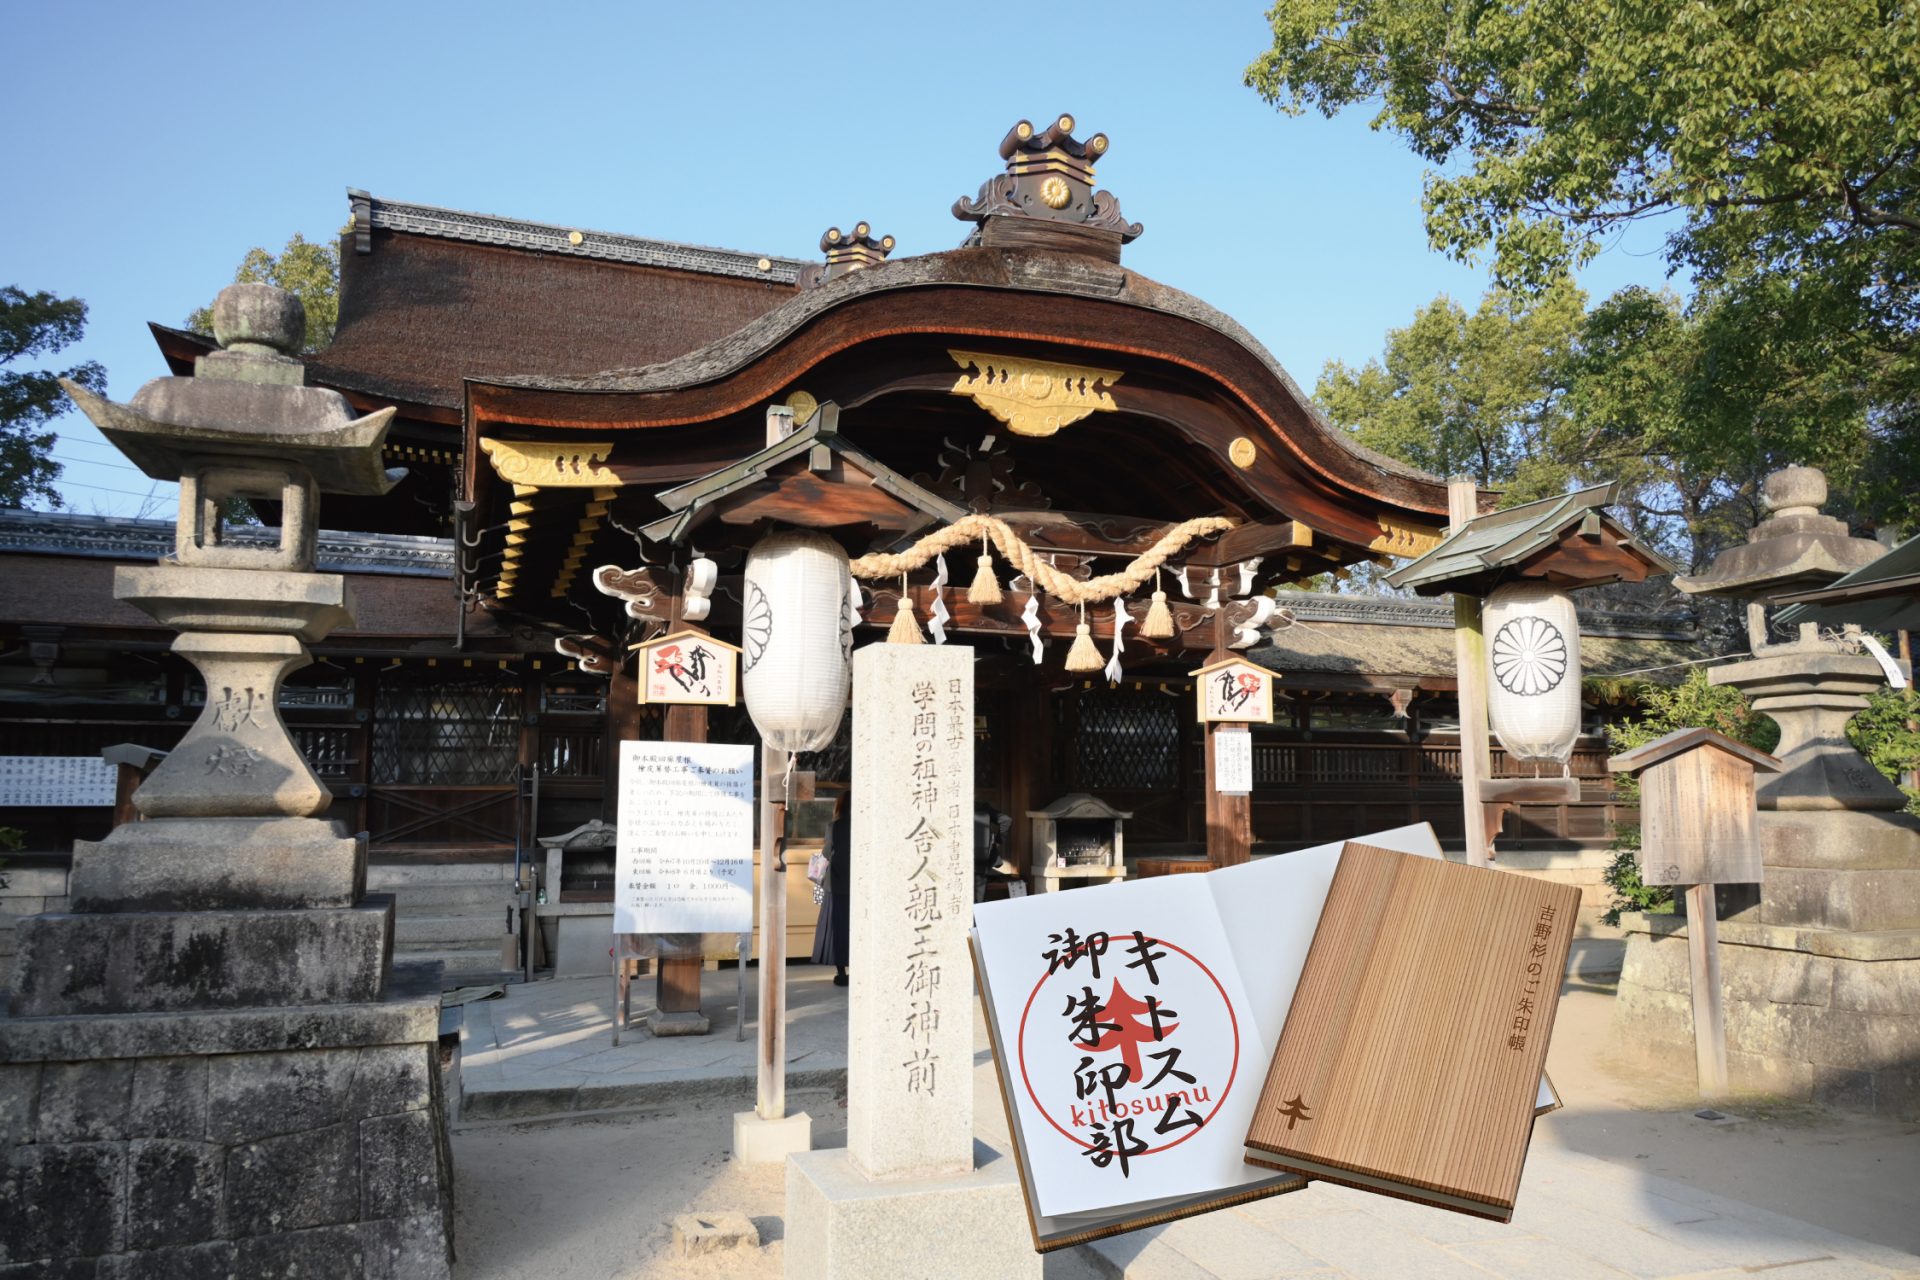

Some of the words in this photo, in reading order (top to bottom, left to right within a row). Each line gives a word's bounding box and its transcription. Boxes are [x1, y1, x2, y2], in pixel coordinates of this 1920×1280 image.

[1125, 931, 1204, 1135] キトスム
[1508, 904, 1556, 1052] 吉野杉のご朱印帳
